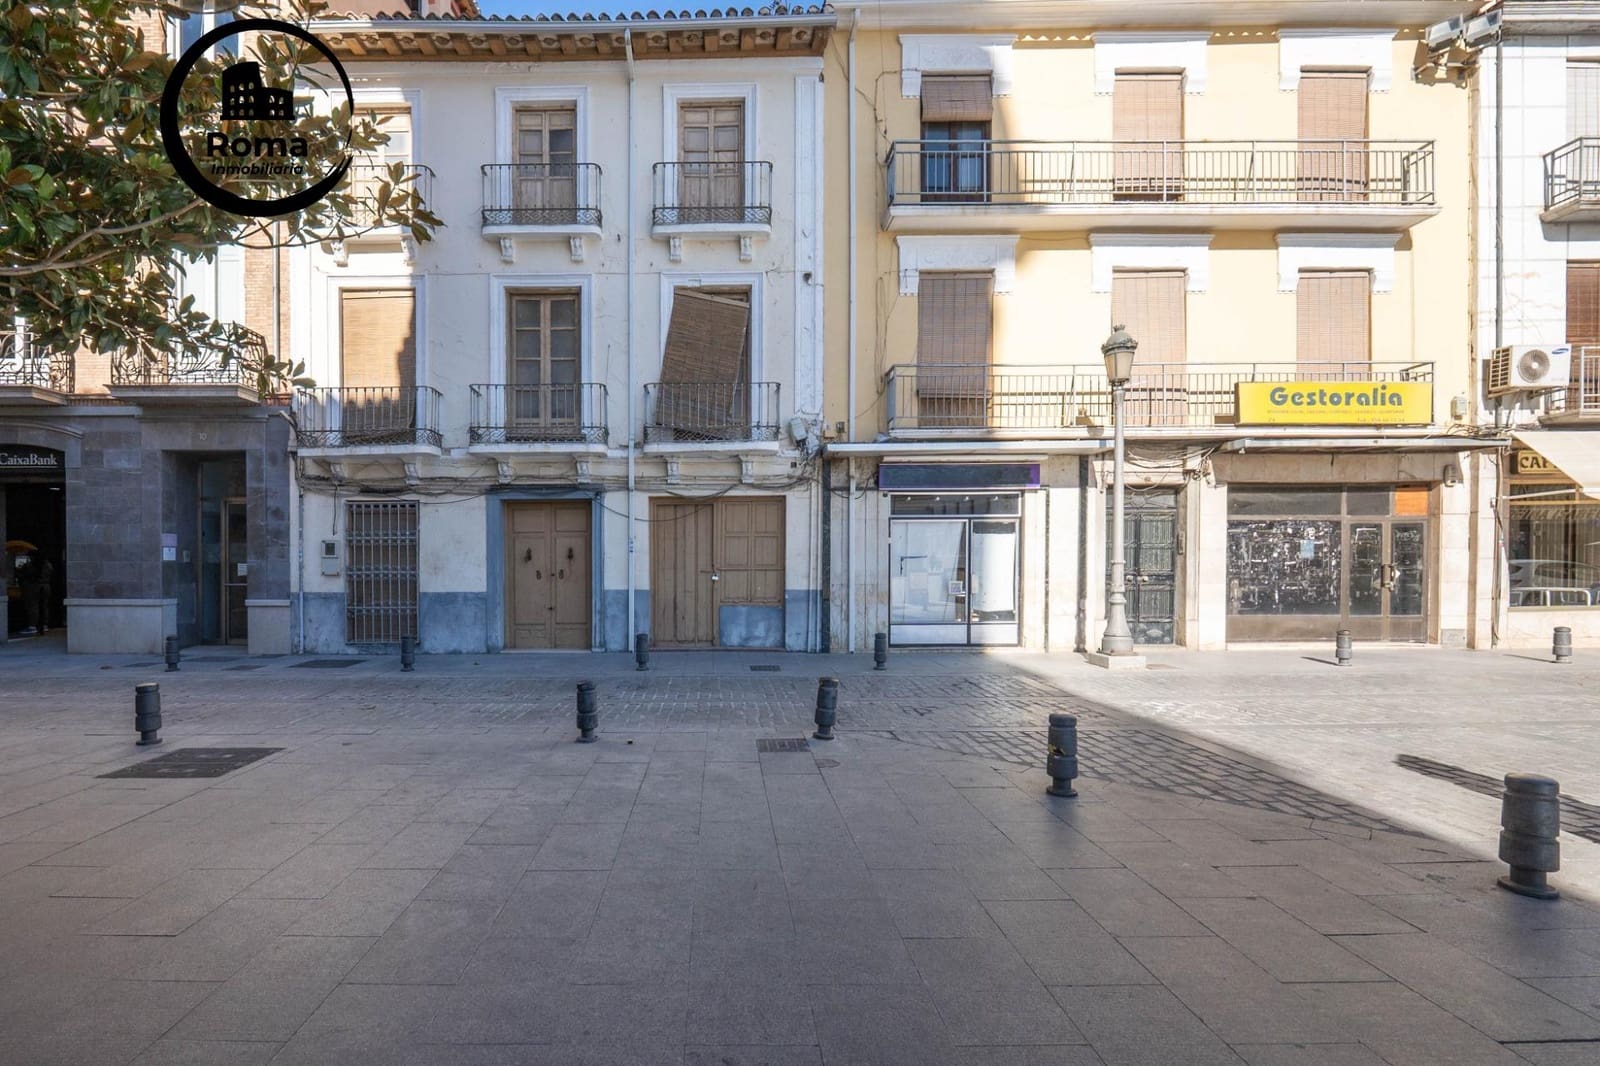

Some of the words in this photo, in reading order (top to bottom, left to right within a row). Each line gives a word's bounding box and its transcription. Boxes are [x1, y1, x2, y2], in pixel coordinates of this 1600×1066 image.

[1269, 385, 1403, 406] Gestoralia
[0, 452, 58, 465] CaixaBank
[1519, 455, 1559, 469] CAF
